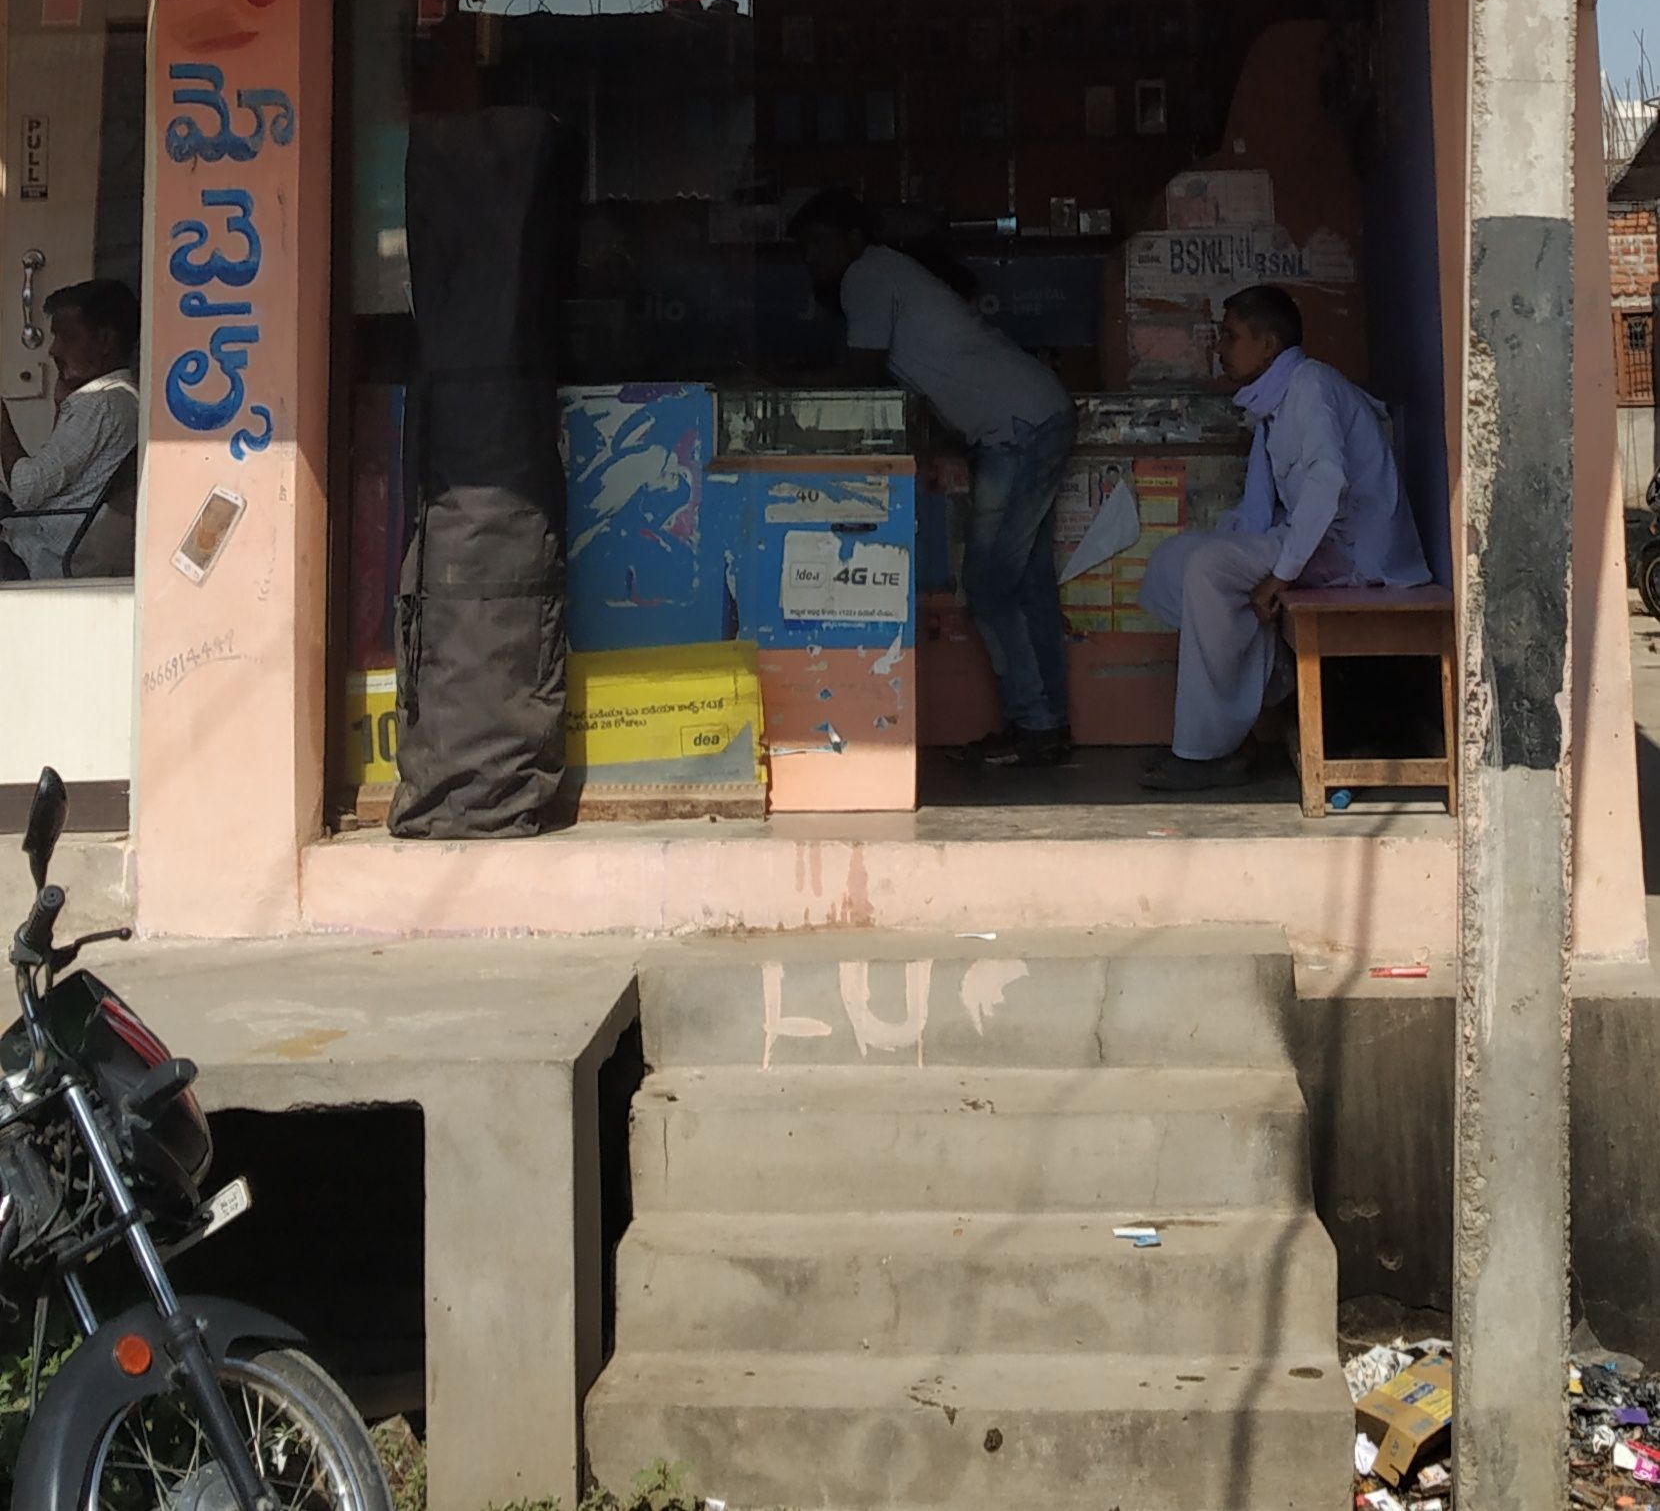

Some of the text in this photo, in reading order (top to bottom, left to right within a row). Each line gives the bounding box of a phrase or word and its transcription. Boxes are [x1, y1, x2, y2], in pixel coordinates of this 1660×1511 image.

[27, 120, 41, 182] PULL
[1254, 252, 1311, 276] BSNL
[833, 568, 867, 585] 4G
[872, 573, 900, 586] LTE
